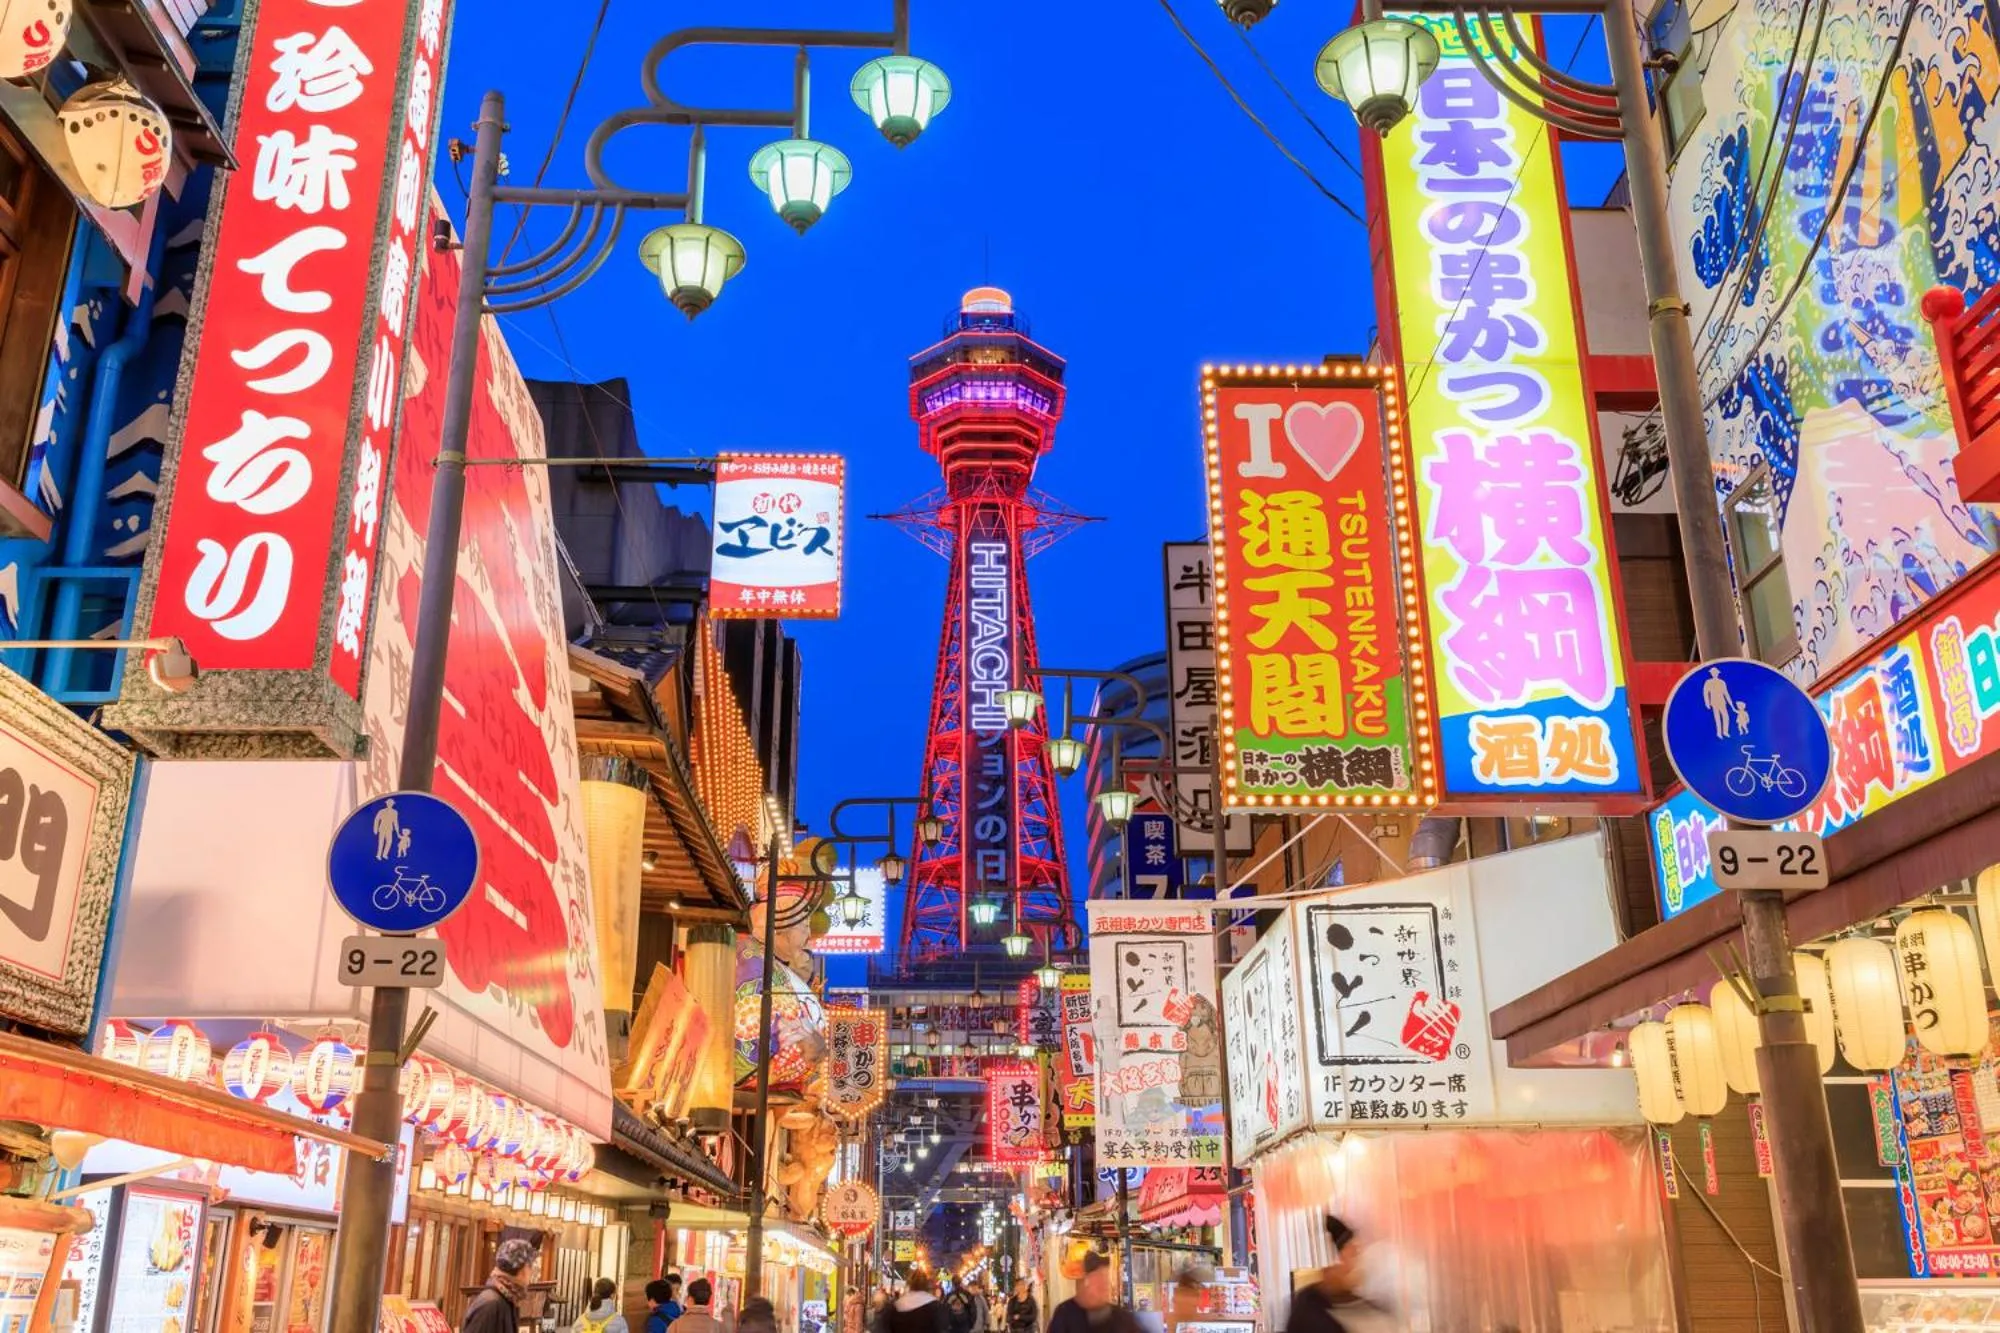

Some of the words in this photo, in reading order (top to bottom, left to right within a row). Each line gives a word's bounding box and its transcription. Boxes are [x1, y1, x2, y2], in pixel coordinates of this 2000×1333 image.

[1418, 66, 1543, 424] 日本一の串かつ
[183, 0, 374, 642] 珍味てっちり
[739, 589, 807, 605] 年中無休
[1427, 432, 1611, 706] 横綱
[971, 543, 1009, 730] HITACHI
[1237, 488, 1346, 738] 通天閣
[1337, 489, 1388, 735] TSUTENKAKU
[1242, 751, 1297, 765] 日本一の
[1244, 769, 1298, 786] 串かつ
[1299, 746, 1394, 788] 横綱
[1474, 720, 1613, 784] 酒処
[1144, 821, 1166, 866] 喫茶
[1095, 914, 1206, 931] 元祖串カツ専門店
[1393, 924, 1424, 988] 新世界
[1065, 994, 1090, 1009] 新世
[1903, 951, 1939, 1031] 串かつ
[851, 1022, 877, 1087] 串かつ
[1324, 1075, 1342, 1092] 1F
[1349, 1074, 1467, 1093] カウンター席
[1010, 1080, 1037, 1139] 串かつ
[1324, 1101, 1343, 1118] 2F
[1350, 1099, 1469, 1120] 座敷あります
[1103, 1140, 1219, 1159] 宴会予約受付中
